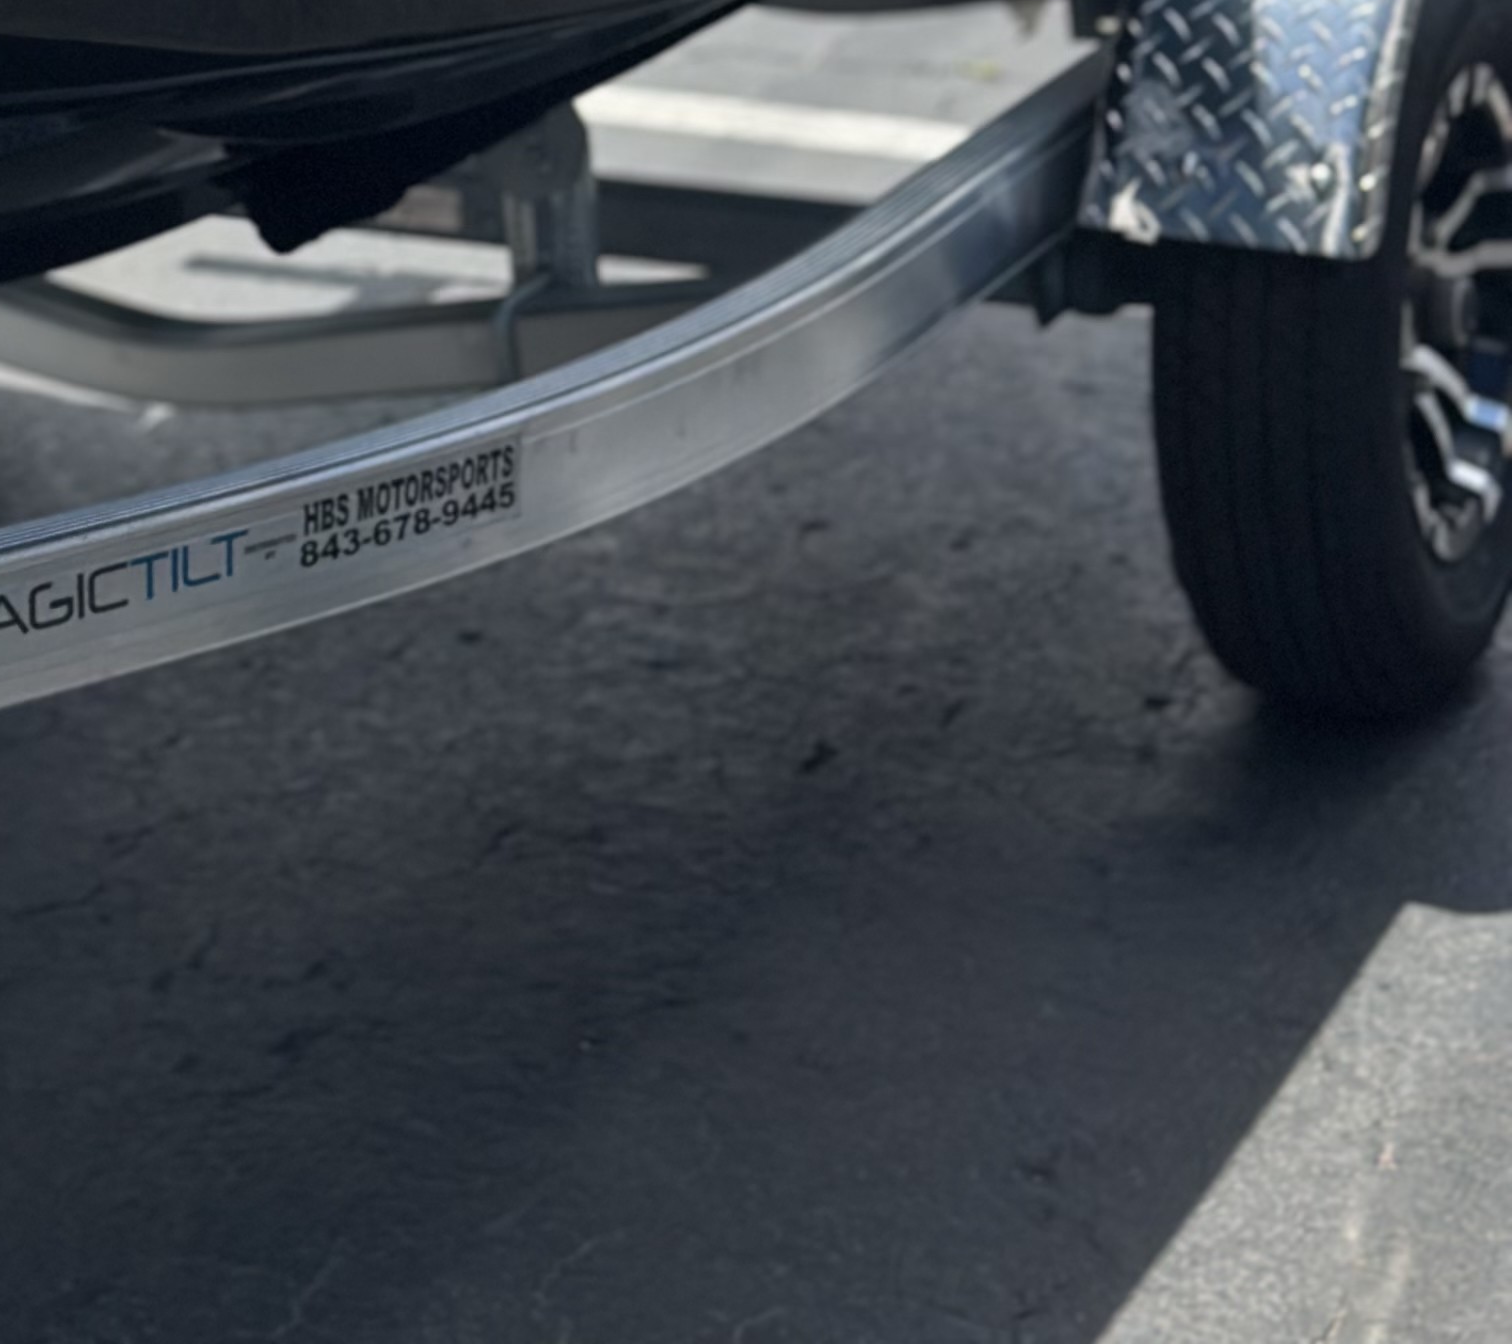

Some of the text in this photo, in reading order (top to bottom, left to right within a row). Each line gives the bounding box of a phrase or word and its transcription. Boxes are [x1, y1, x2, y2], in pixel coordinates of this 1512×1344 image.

[300, 482, 516, 568] 843-678-9445
[302, 444, 515, 536] HBS MOTORSPORTS
